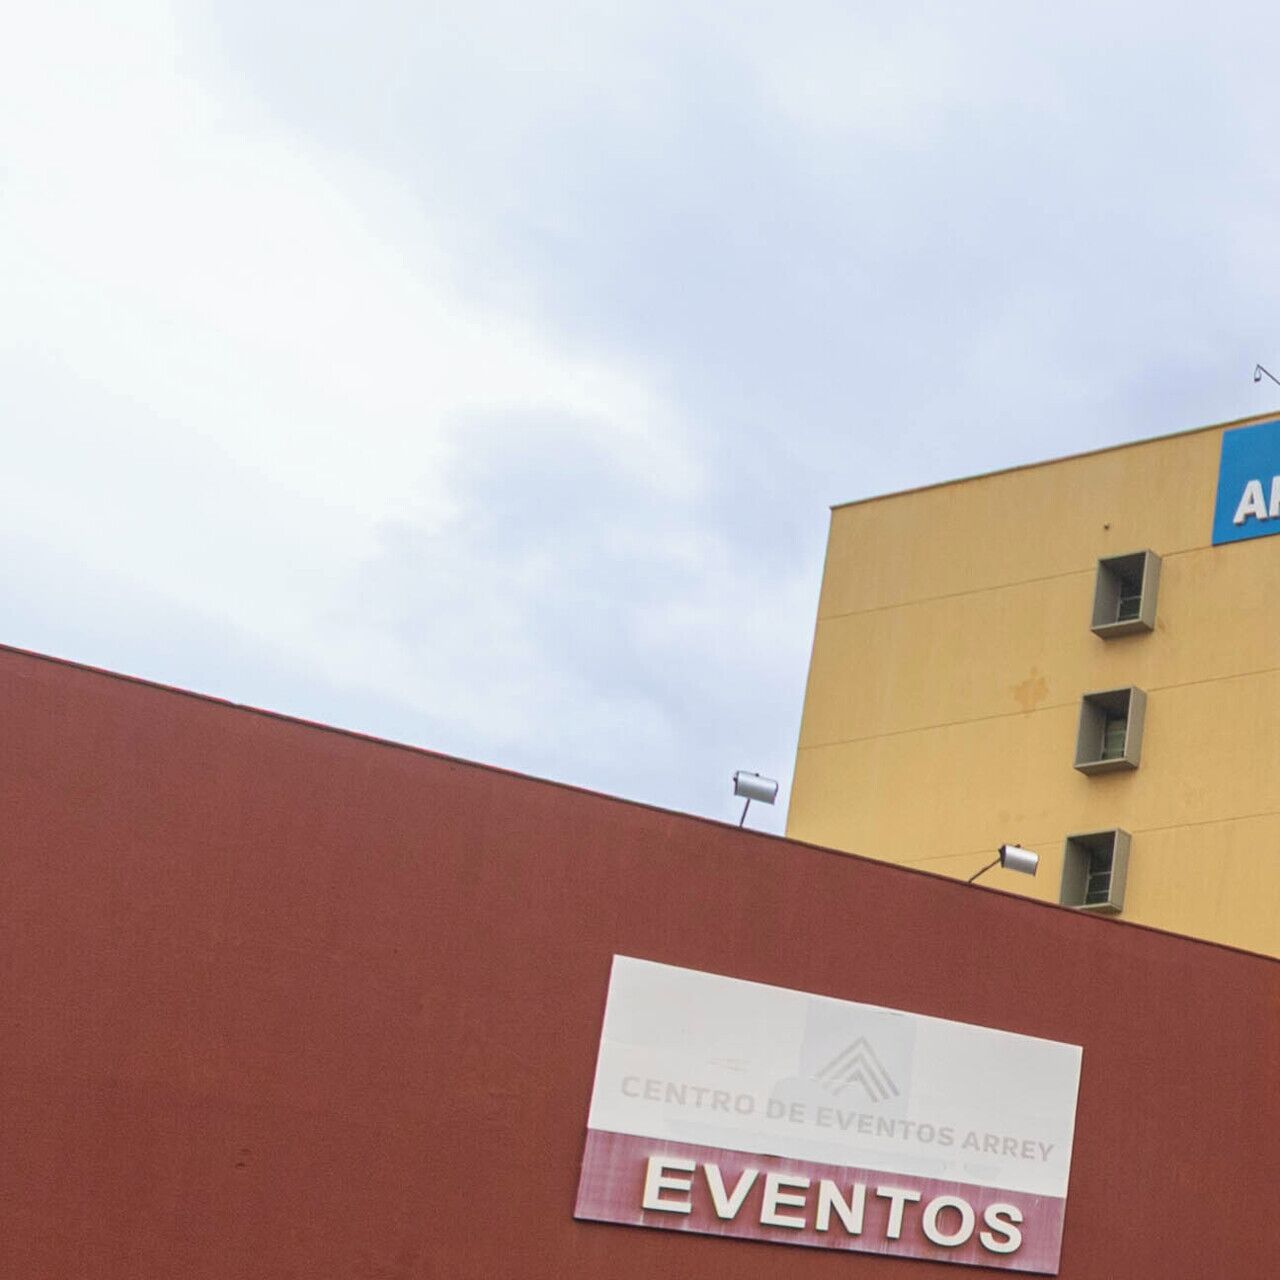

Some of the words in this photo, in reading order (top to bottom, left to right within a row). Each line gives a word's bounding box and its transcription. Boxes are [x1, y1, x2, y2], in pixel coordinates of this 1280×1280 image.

[620, 1075, 756, 1116] CENTRO
[766, 1099, 805, 1124] DE
[815, 1106, 955, 1147] EVENTOS
[962, 1131, 1056, 1163] ARREY
[642, 1156, 1024, 1254] EVENTOS
